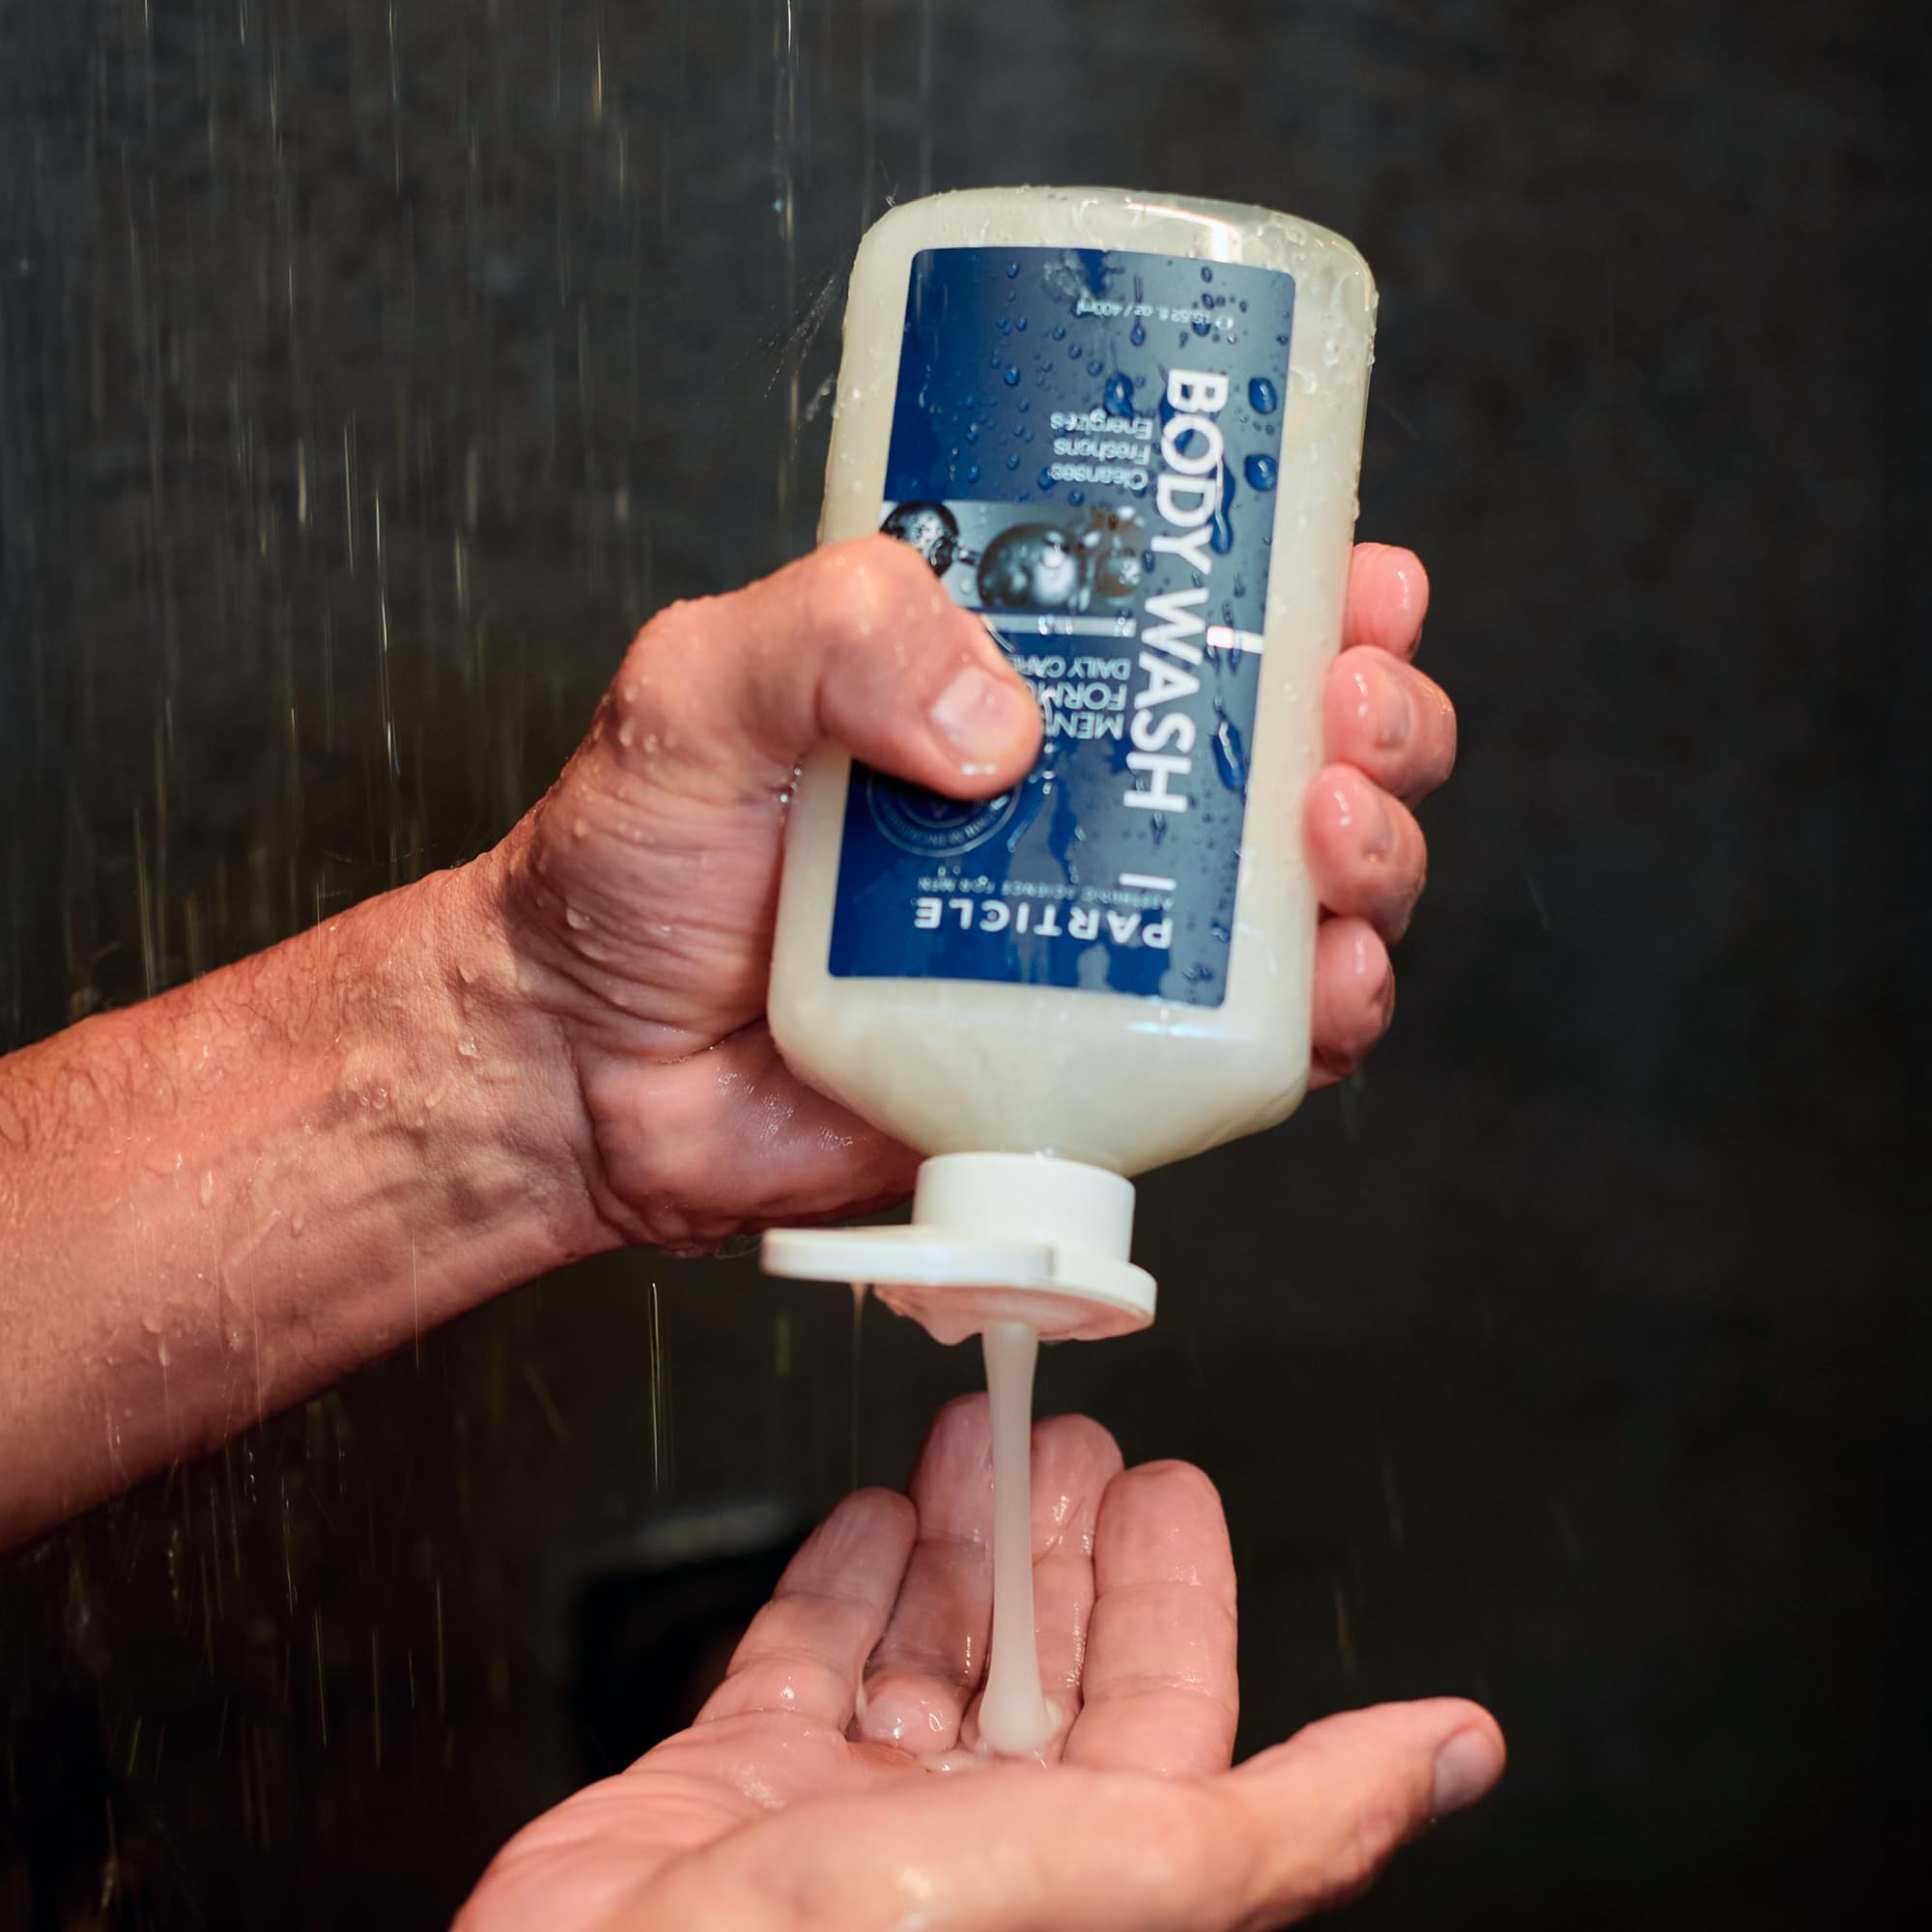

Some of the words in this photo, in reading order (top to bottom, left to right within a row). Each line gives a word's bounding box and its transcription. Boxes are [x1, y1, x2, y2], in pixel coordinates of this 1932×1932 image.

[1050, 408, 1152, 440] Energizes
[1053, 437, 1151, 465] Freshens
[1050, 463, 1149, 490] Cleanses
[1151, 368, 1229, 576] BODY
[1067, 656, 1131, 680] DAILY
[1123, 586, 1209, 813] WASH
[914, 896, 1174, 950] PARTICLE
